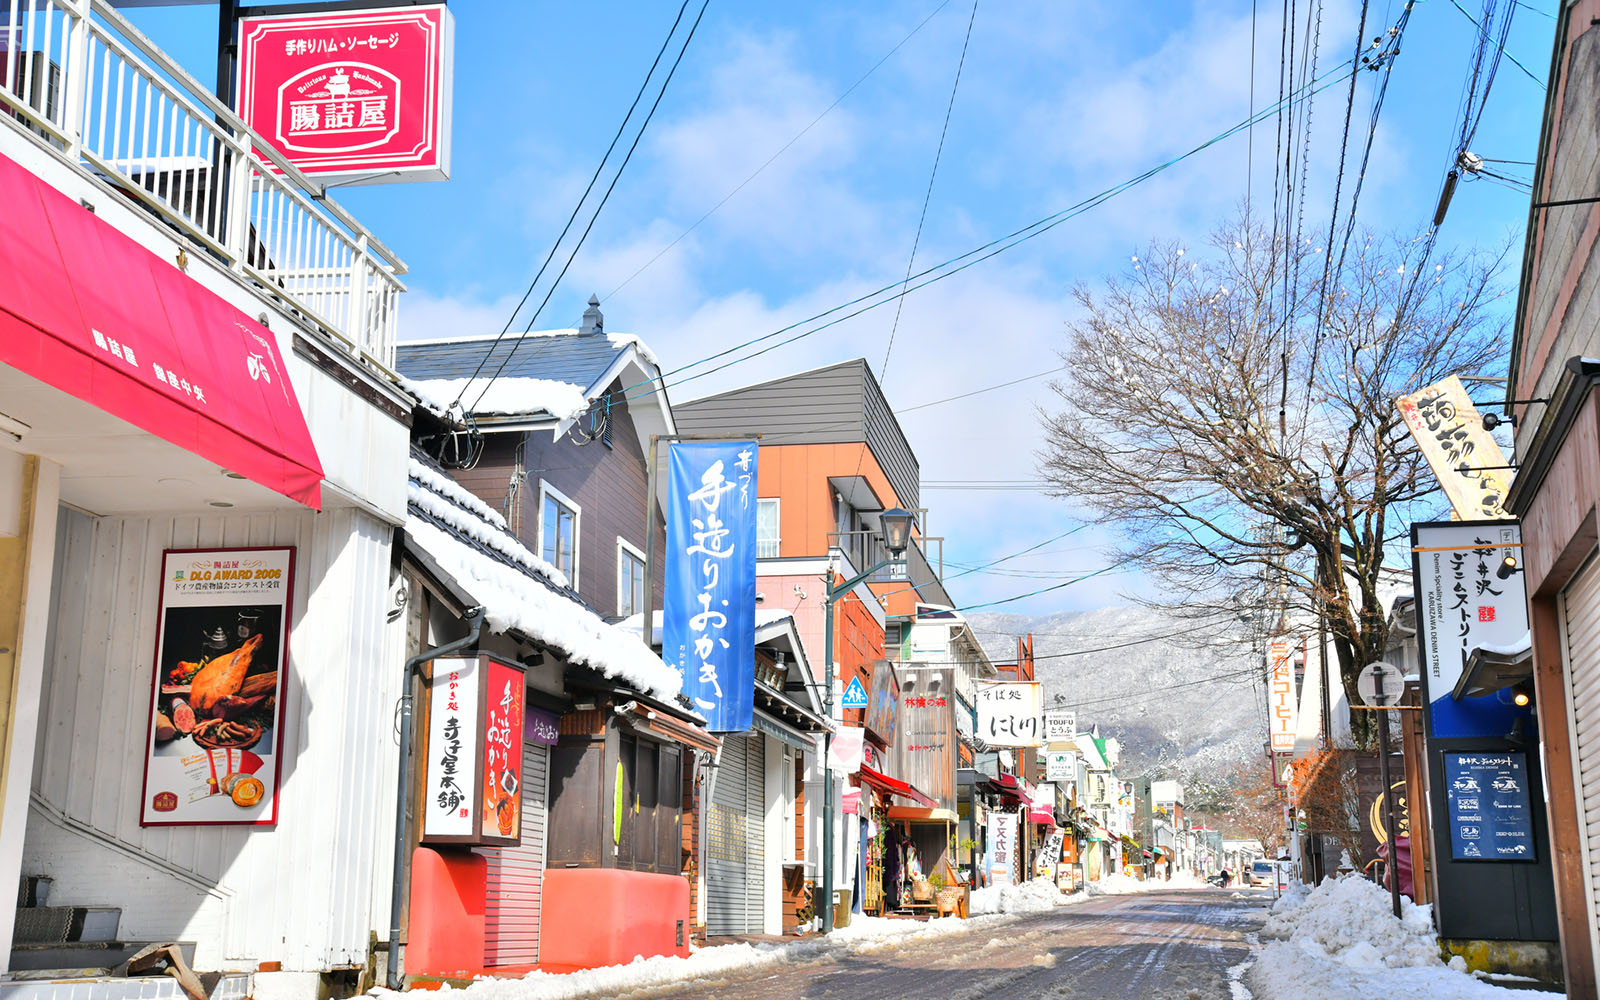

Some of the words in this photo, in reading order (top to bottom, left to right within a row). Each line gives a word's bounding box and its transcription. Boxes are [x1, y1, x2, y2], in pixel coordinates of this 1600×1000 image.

[285, 32, 399, 56] 手作りハム・ソーセージ
[289, 99, 388, 132] 腸詰屋
[189, 570, 212, 581] DLG
[213, 569, 253, 580] AWARD
[253, 568, 282, 579] 2006
[687, 458, 737, 711] 手造りおかき
[1433, 552, 1441, 574] Denim
[1437, 602, 1445, 619] store
[1428, 591, 1437, 631] KARUIZAWA
[1430, 631, 1439, 654] DENIM
[1432, 654, 1441, 678] STREET
[446, 671, 459, 711] おかき処
[983, 689, 1022, 700] そば処
[1050, 726, 1073, 734] とうふ
[437, 716, 466, 817] 寺子屋本舗
